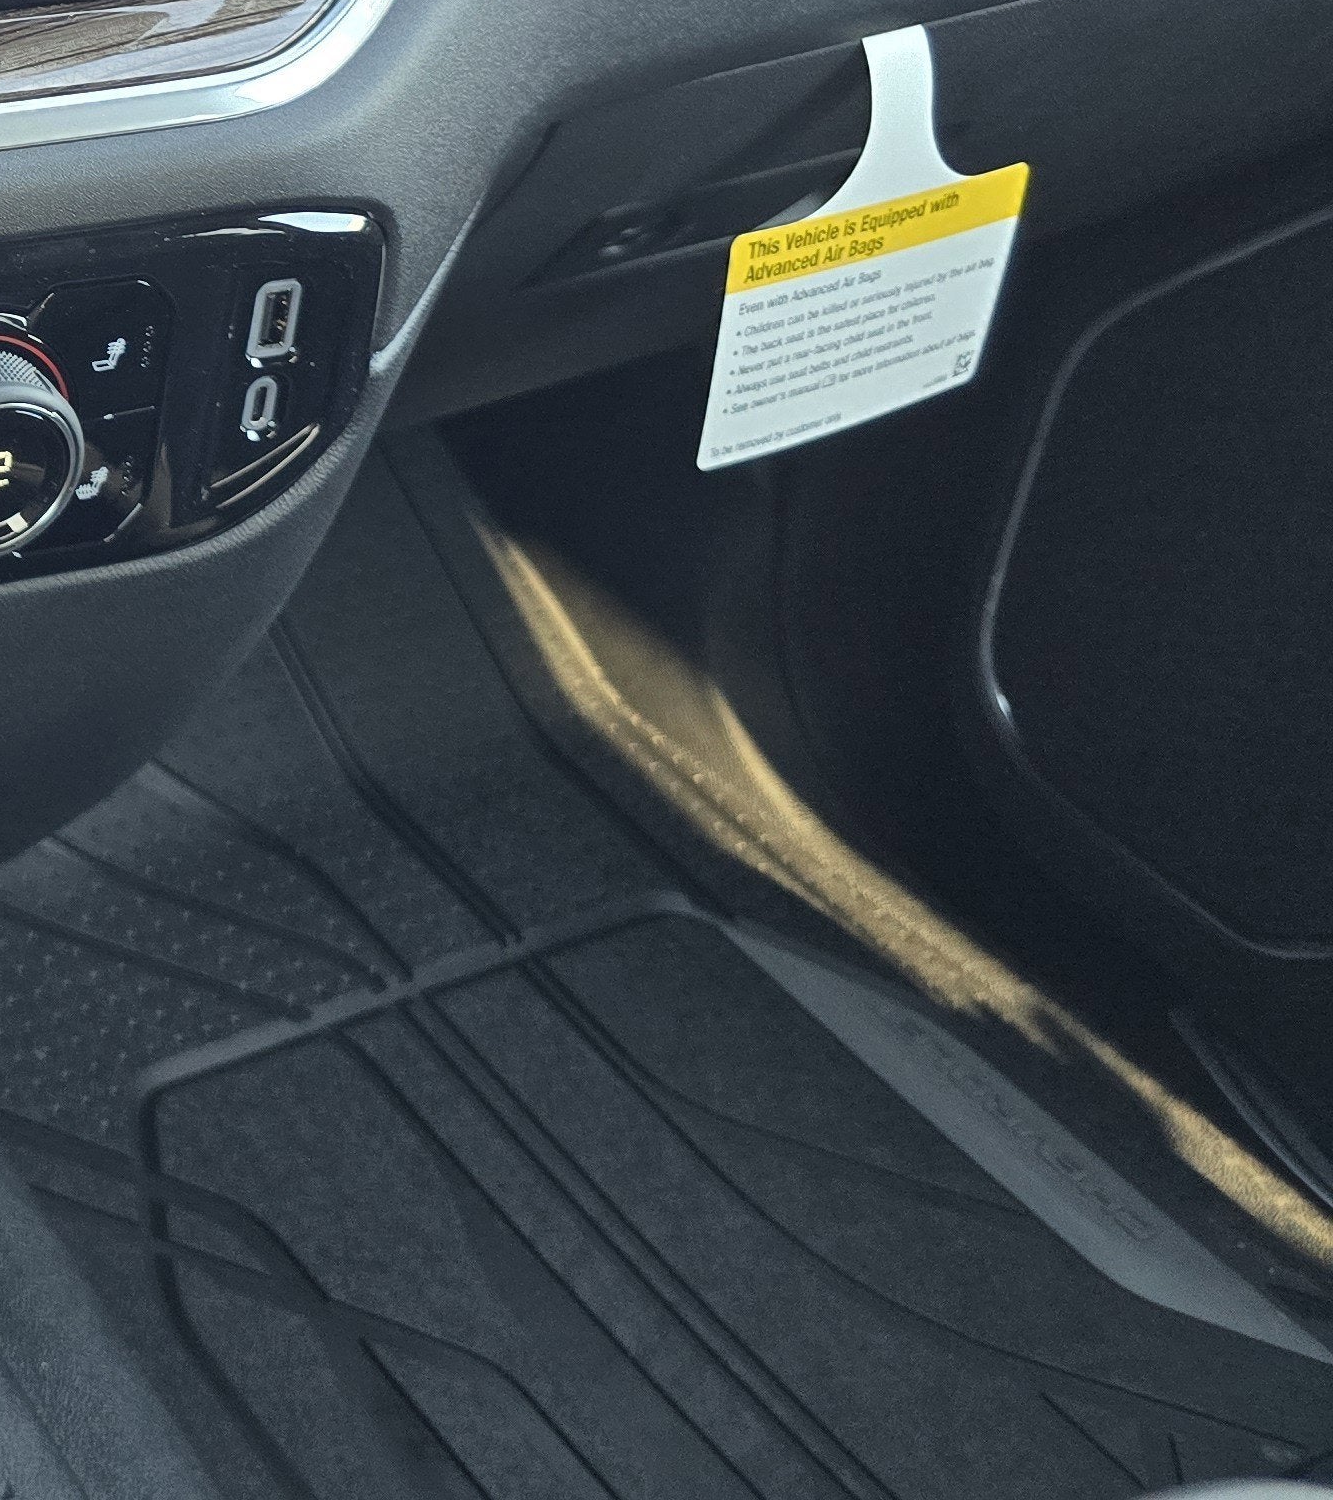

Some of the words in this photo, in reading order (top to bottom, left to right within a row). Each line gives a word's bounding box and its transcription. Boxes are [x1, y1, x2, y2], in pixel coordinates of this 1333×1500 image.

[748, 237, 780, 260] This
[785, 223, 840, 251] Vehicle
[843, 218, 857, 237] is
[860, 199, 927, 233] Equipped
[930, 191, 960, 214] with
[743, 249, 820, 284] Advanced
[822, 245, 845, 265] Air
[848, 236, 885, 257] Bags
[738, 302, 764, 316] Even
[792, 280, 841, 301] Advanced
